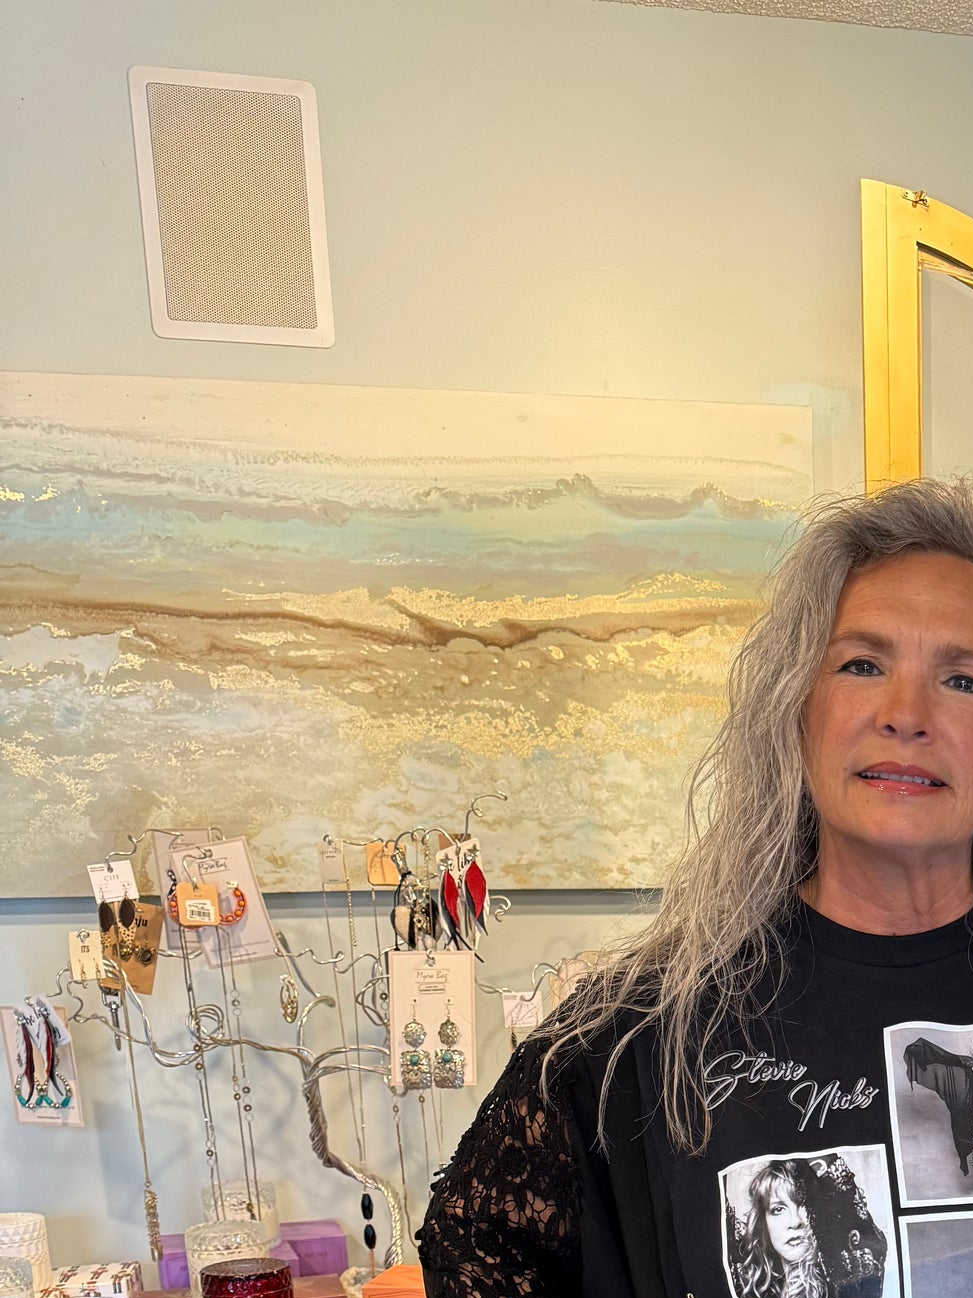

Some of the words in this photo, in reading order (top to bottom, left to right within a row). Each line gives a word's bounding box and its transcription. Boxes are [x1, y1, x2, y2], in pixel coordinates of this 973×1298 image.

[416, 970, 433, 983] Myra
[435, 970, 449, 983] Bag
[704, 1050, 808, 1112] Stevie
[787, 1076, 880, 1132] Nicks
